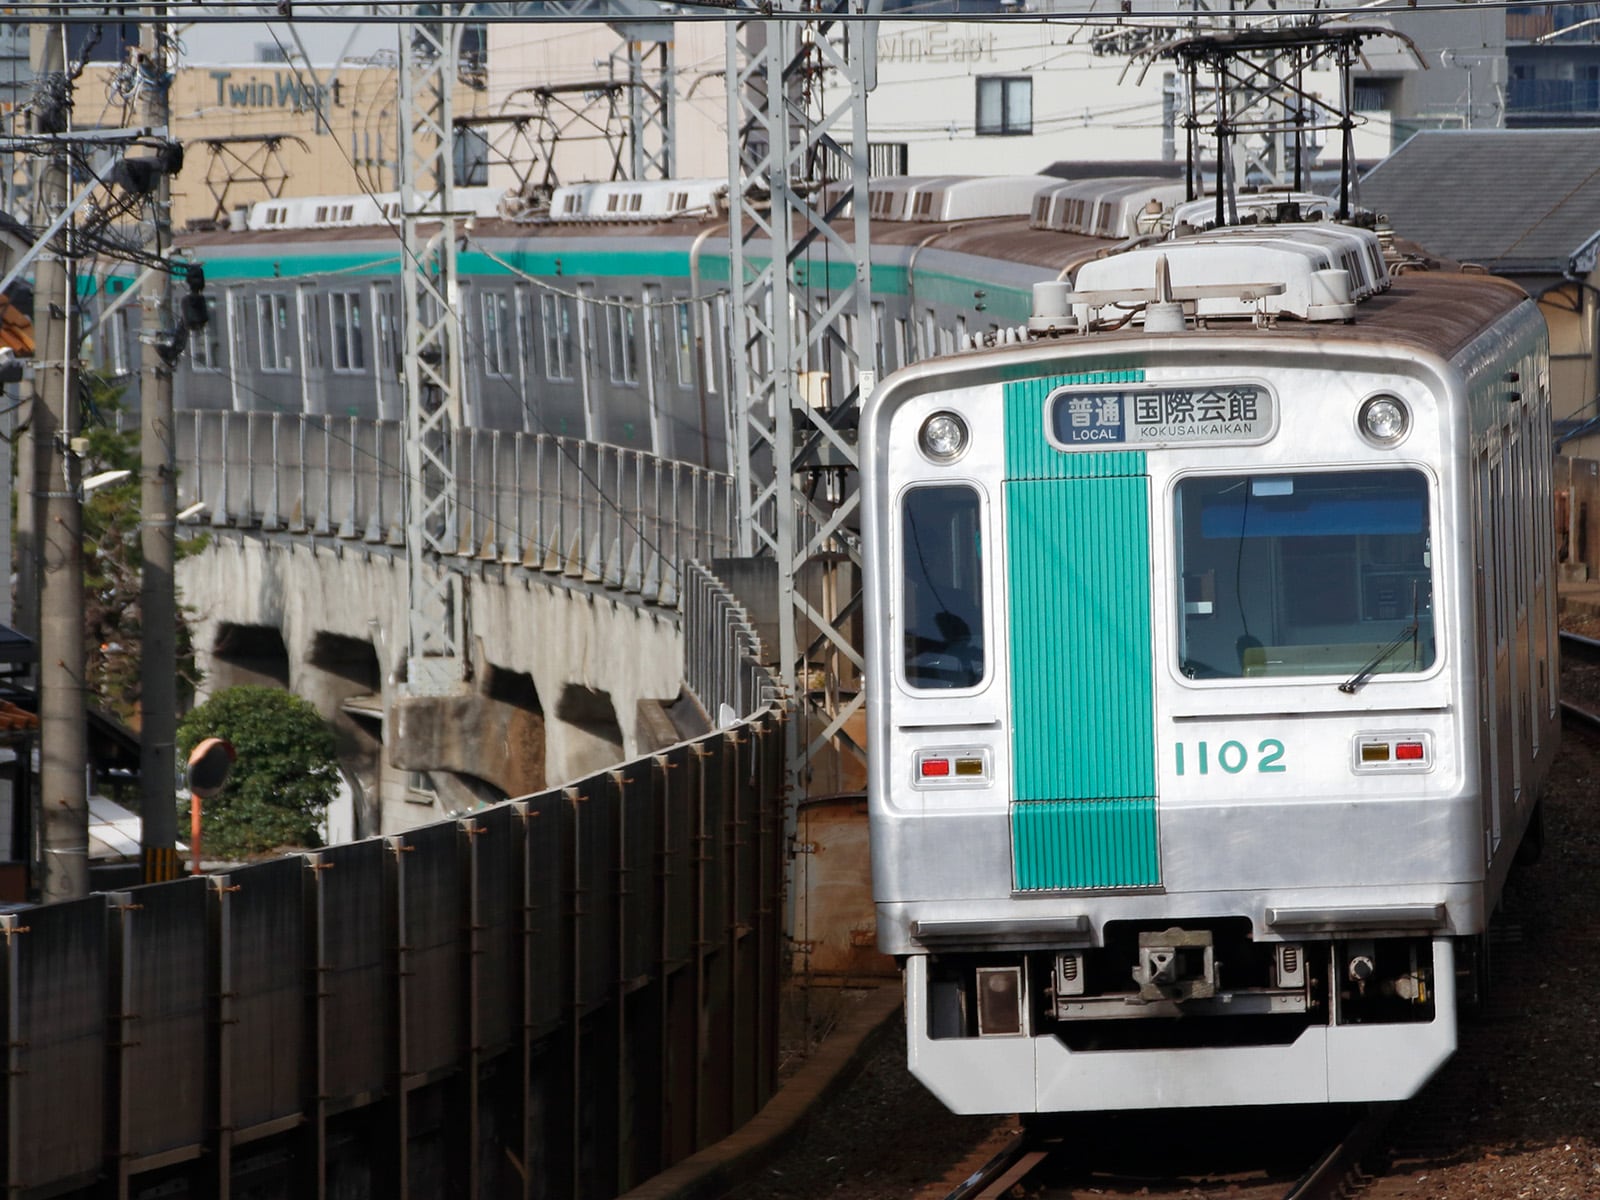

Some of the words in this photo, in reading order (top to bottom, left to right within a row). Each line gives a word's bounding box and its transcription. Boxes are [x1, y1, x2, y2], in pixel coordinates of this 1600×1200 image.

[877, 23, 997, 63] winEast
[1068, 397, 1121, 427] 普通
[1134, 390, 1257, 425] 国際会館
[1072, 429, 1117, 441] LOCAL
[1140, 423, 1252, 437] KOKUSAIKAIKAN
[1175, 738, 1287, 776] 1102
